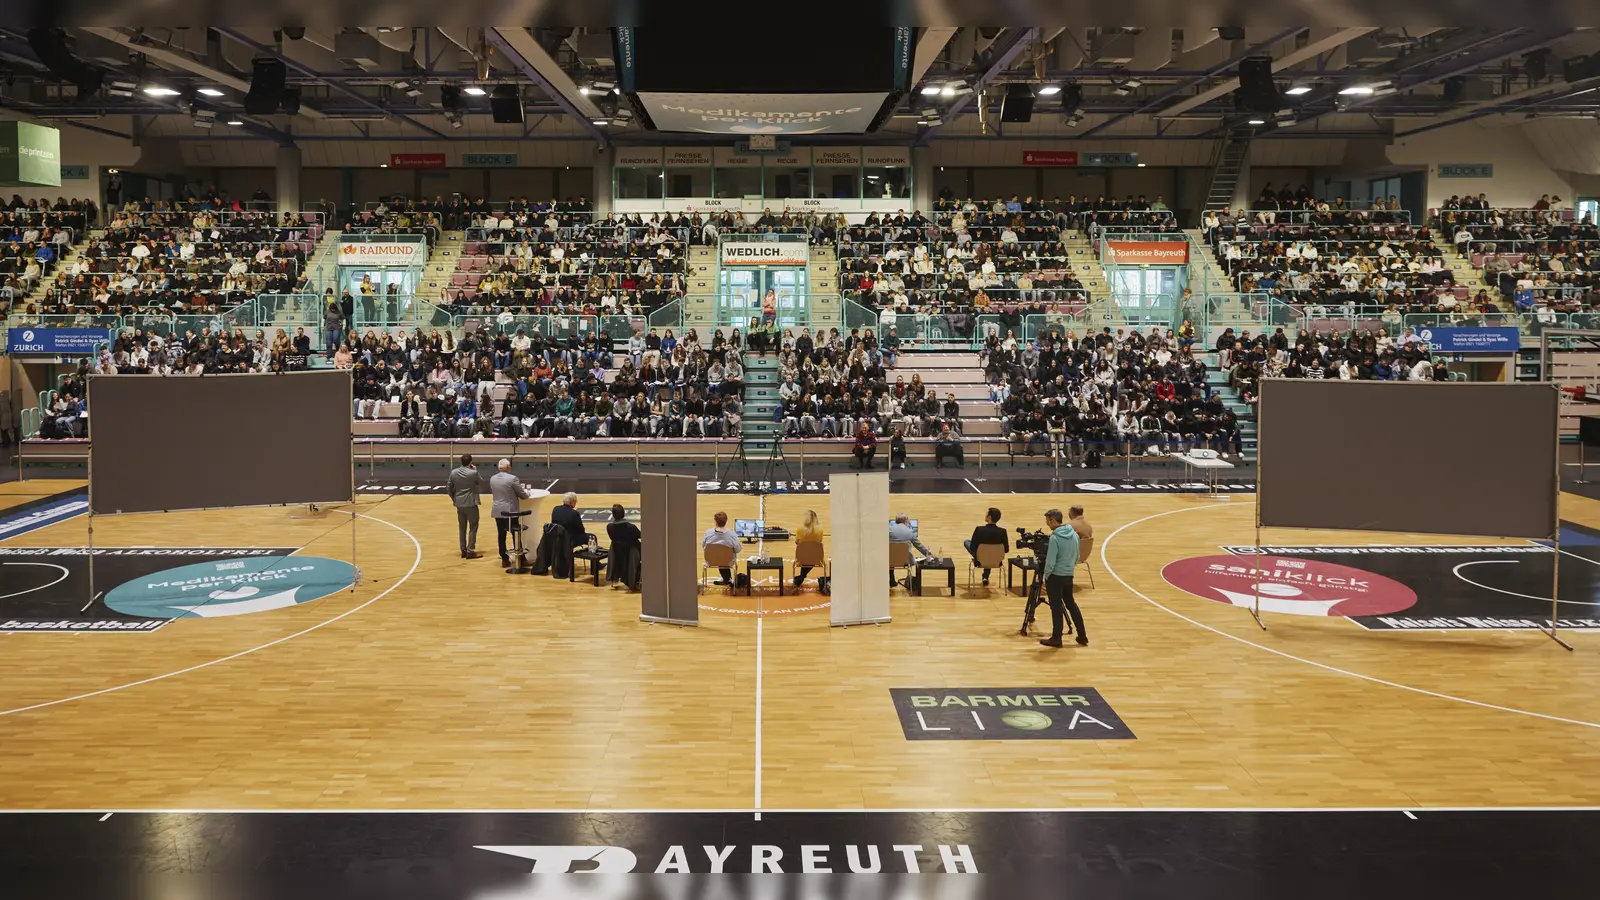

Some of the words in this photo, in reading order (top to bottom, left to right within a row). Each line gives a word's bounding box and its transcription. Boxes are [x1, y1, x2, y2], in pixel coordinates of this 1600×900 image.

[662, 104, 862, 119] Medikamente
[701, 115, 749, 123] per
[757, 116, 823, 124] Klick
[468, 155, 500, 164] BLOCK
[360, 245, 413, 255] RAIMUND
[726, 247, 804, 257] WEDLICH.com
[1117, 249, 1152, 258] Sparkasse
[1154, 249, 1185, 258] Bayreuth
[148, 565, 315, 589] Medikamente
[1208, 563, 1369, 588] saniklick
[181, 580, 220, 592] per
[230, 573, 288, 585] Klick
[910, 695, 1090, 708] BARMER
